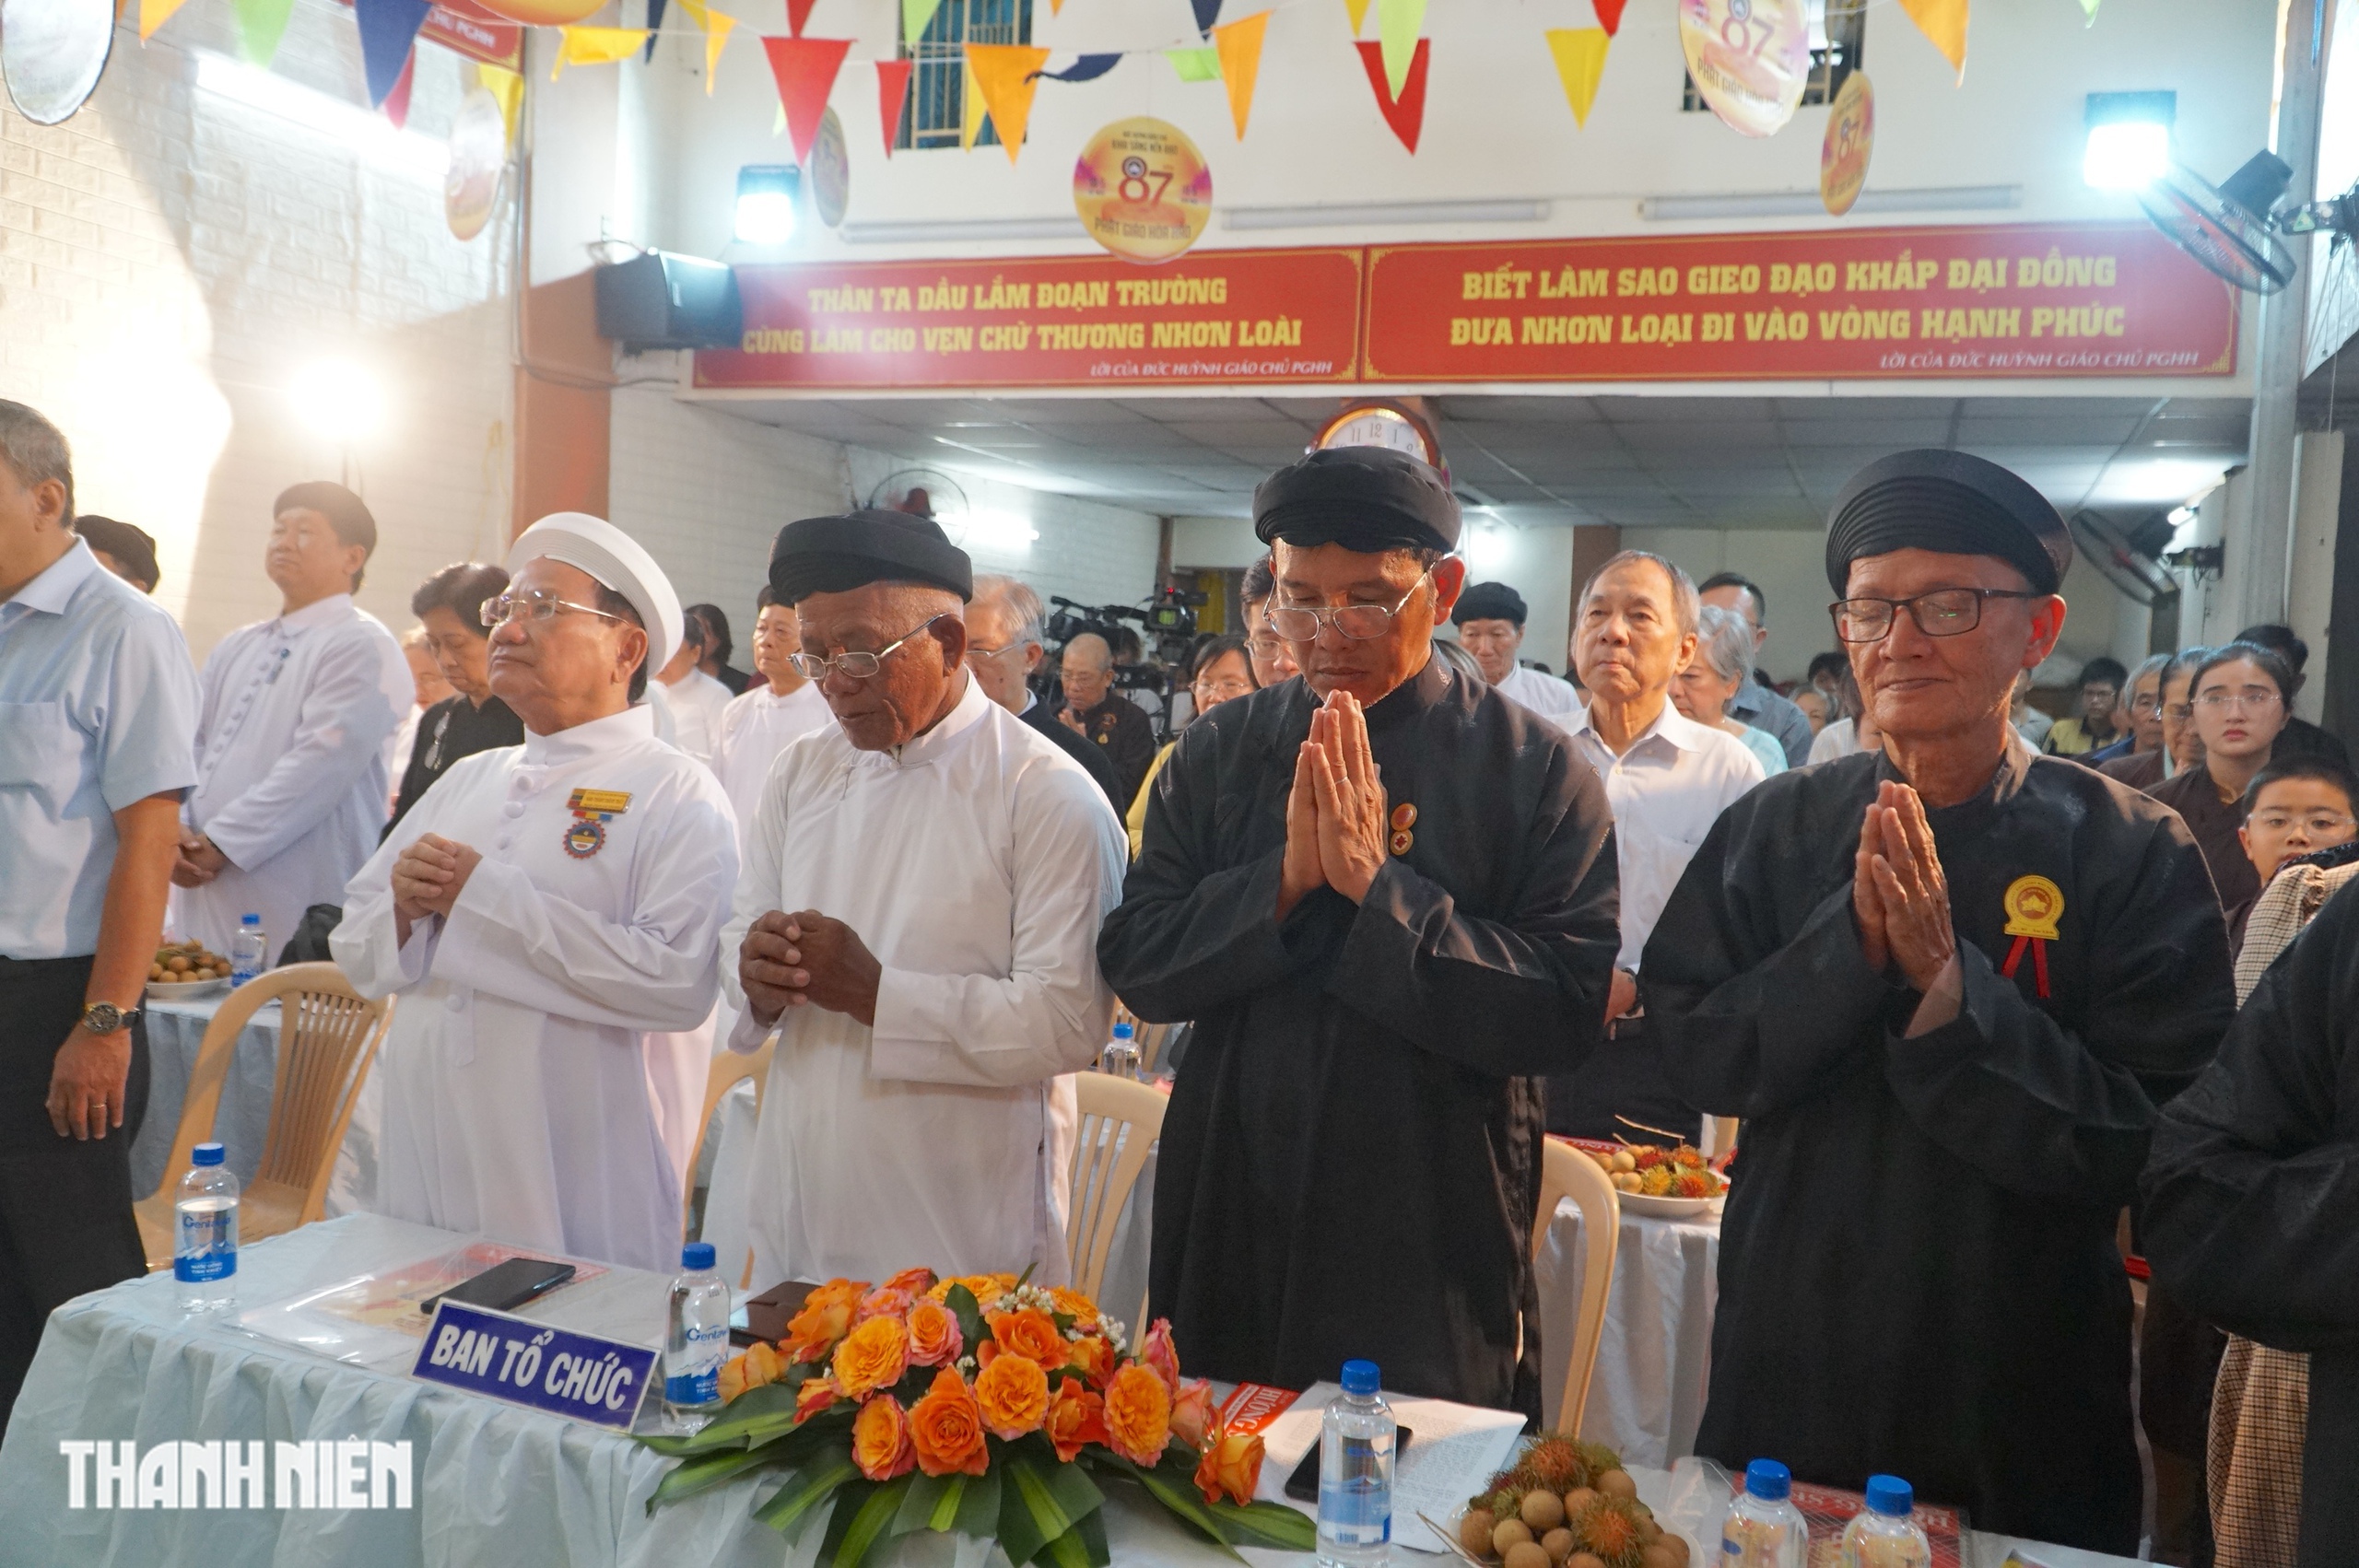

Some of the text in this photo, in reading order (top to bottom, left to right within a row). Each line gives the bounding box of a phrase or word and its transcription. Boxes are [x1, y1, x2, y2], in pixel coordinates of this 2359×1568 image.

[1721, 0, 1776, 59] 87
[1119, 156, 1174, 208] 87
[807, 274, 1227, 313] THÂN TA DẦU LẮM ĐOẠN TRƯỜNG
[1462, 246, 2116, 300] BIẾT LÀM SAO GIEO ĐẠO KHẮP ĐẠI ĐỒNG
[870, 327, 916, 353] CHO
[922, 327, 973, 357] VẸN
[1037, 323, 1144, 351] THƯƠNG
[1151, 320, 1233, 348] NHƠN
[1238, 315, 1302, 347] LOÀI
[1450, 300, 2125, 346] ĐƯA NHƠN LOẠI ĐI VÀO VÒNG HẠNH PHÚC
[1112, 359, 1139, 377] CỦA
[1143, 360, 1167, 376] ĐỨC
[1224, 359, 1258, 376] GIÁO
[1260, 357, 1290, 375] CHỦ
[1292, 361, 1332, 374] PGHH
[1880, 351, 1906, 369] LỜI
[1909, 349, 1943, 369] CỦA
[1949, 351, 1982, 369] ĐỨC
[2056, 351, 2100, 368] GIÁO
[2105, 349, 2142, 367] CHỦ
[2145, 353, 2199, 366] PGHH
[1351, 428, 1360, 442] 11
[1369, 424, 1382, 438] 12
[429, 1324, 633, 1410] BAN TỔ CHỨC
[1234, 1388, 1284, 1429] HƯƠNG
